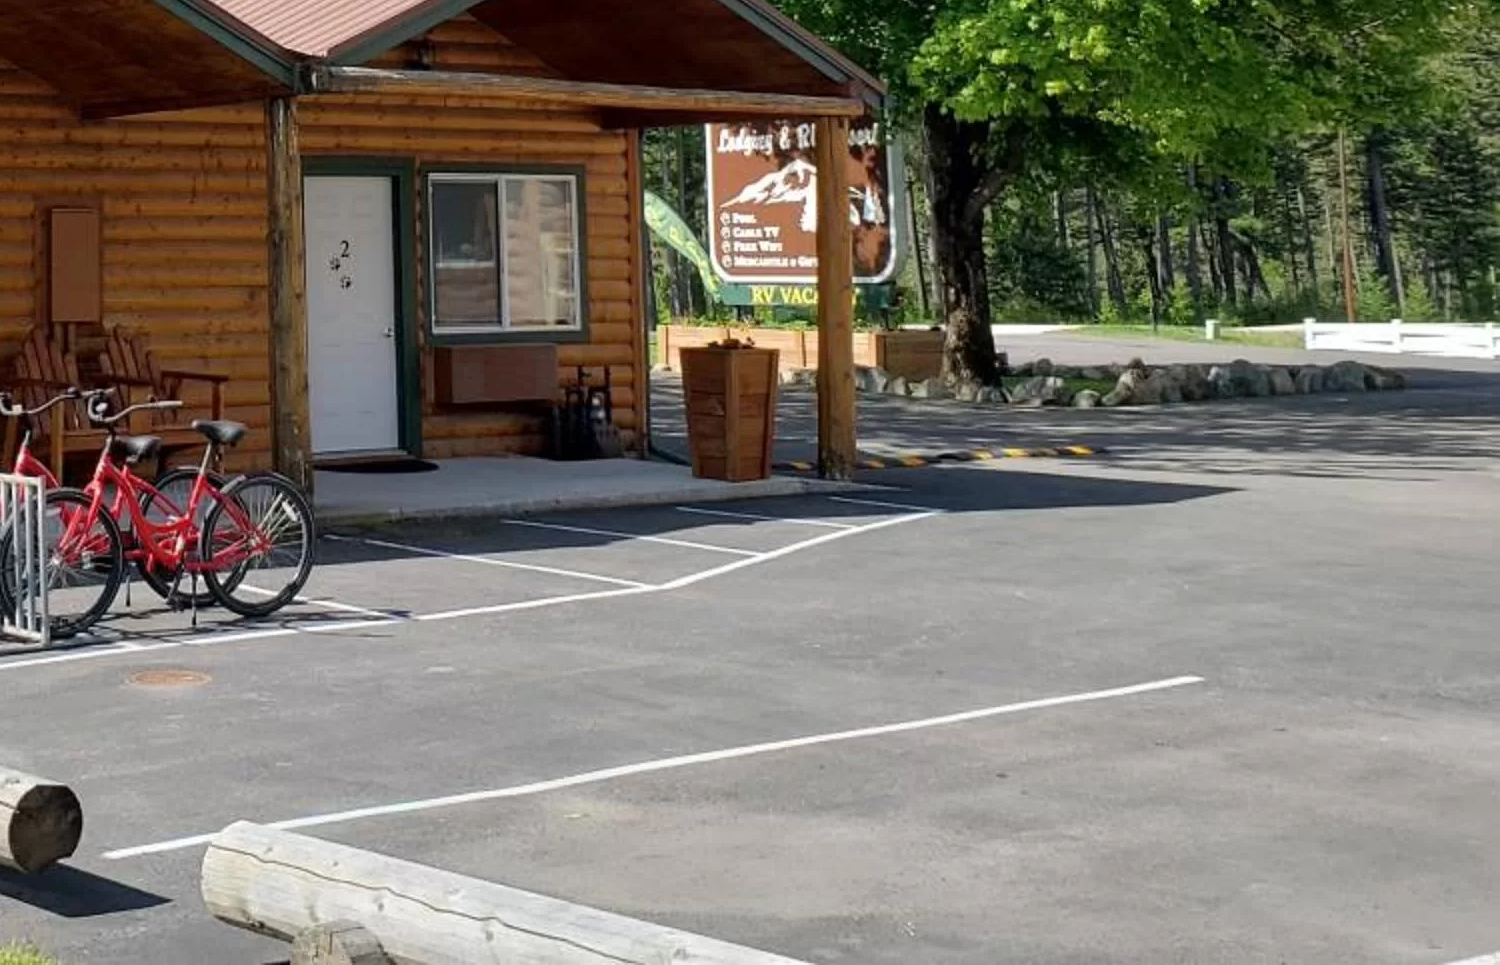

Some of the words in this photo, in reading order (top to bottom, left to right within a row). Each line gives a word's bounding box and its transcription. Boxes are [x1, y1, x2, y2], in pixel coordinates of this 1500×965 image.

[779, 125, 791, 150] &
[763, 225, 781, 239] TV
[339, 240, 350, 258] 2
[751, 285, 775, 305] RV
